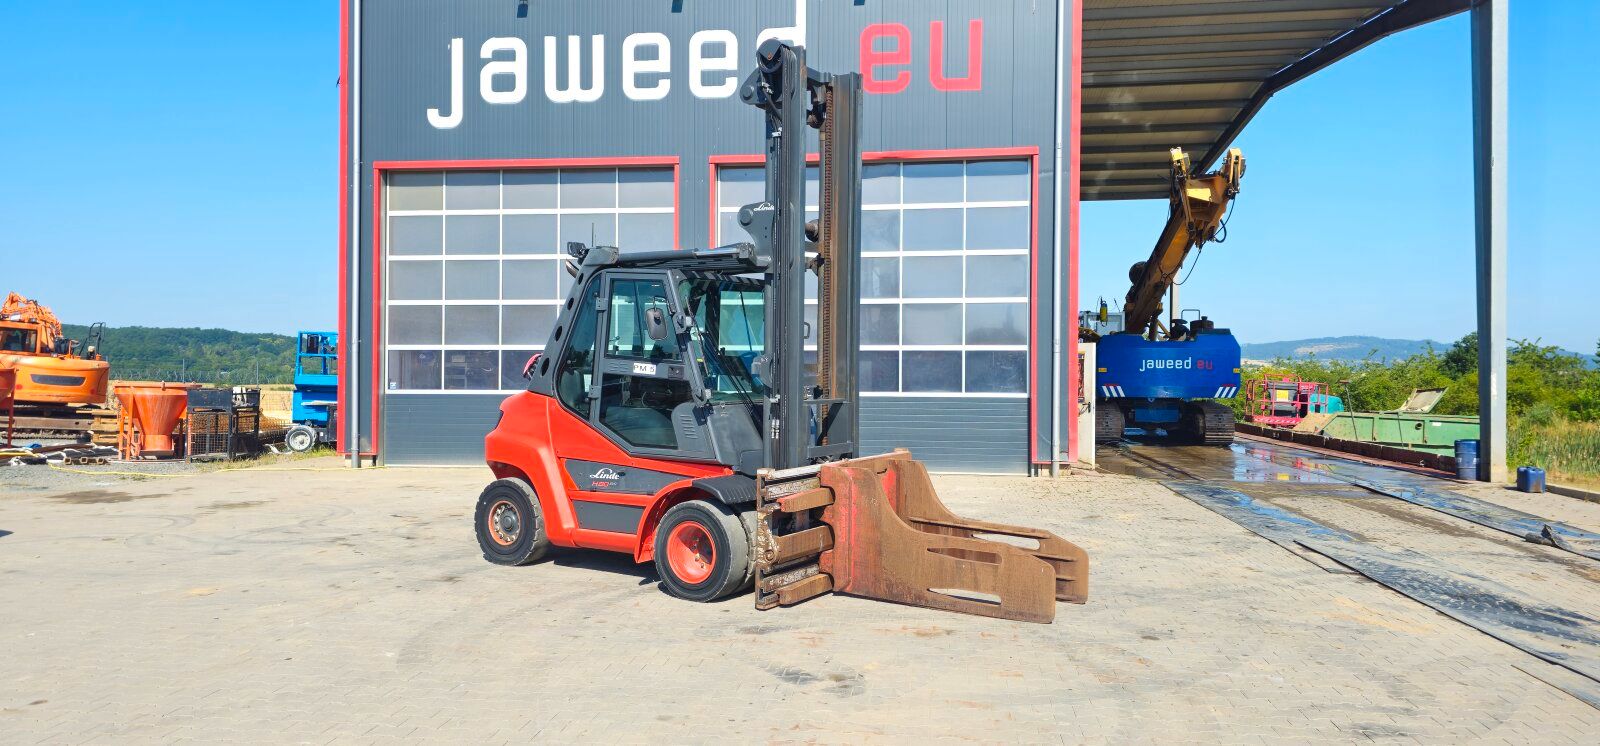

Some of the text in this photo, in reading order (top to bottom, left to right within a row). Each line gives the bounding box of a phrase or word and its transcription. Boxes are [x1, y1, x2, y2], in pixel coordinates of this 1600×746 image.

[860, 19, 983, 94] eu
[1139, 356, 1213, 372] jaweed eu
[589, 467, 620, 480] Linde
